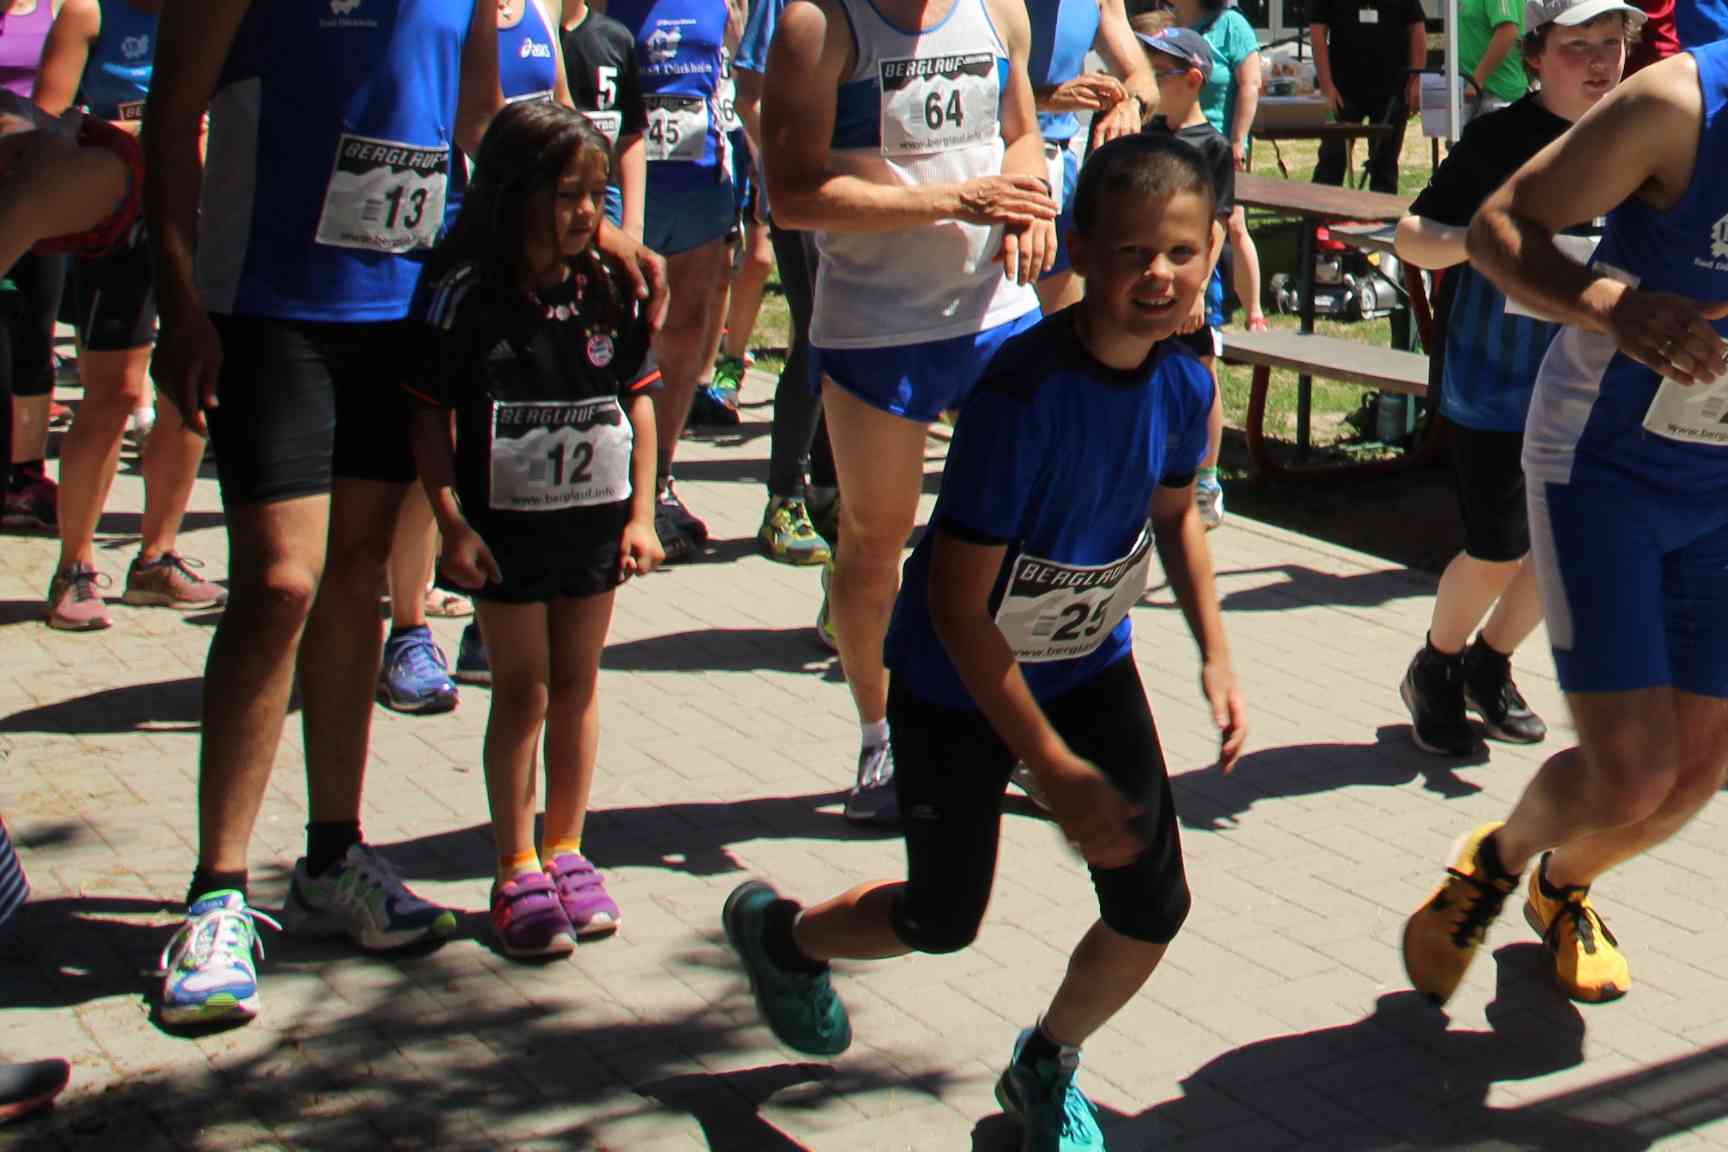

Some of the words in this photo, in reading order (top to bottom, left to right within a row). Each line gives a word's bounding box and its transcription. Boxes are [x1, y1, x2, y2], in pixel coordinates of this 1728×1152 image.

[885, 56, 964, 78] BERGLAUF
[924, 88, 964, 130] 64
[649, 119, 680, 145] 45
[345, 143, 442, 169] BERGLAUF
[385, 185, 428, 230] 13
[501, 404, 596, 425] BERGLAUF
[547, 442, 595, 486] 12
[1050, 594, 1117, 642] 25
